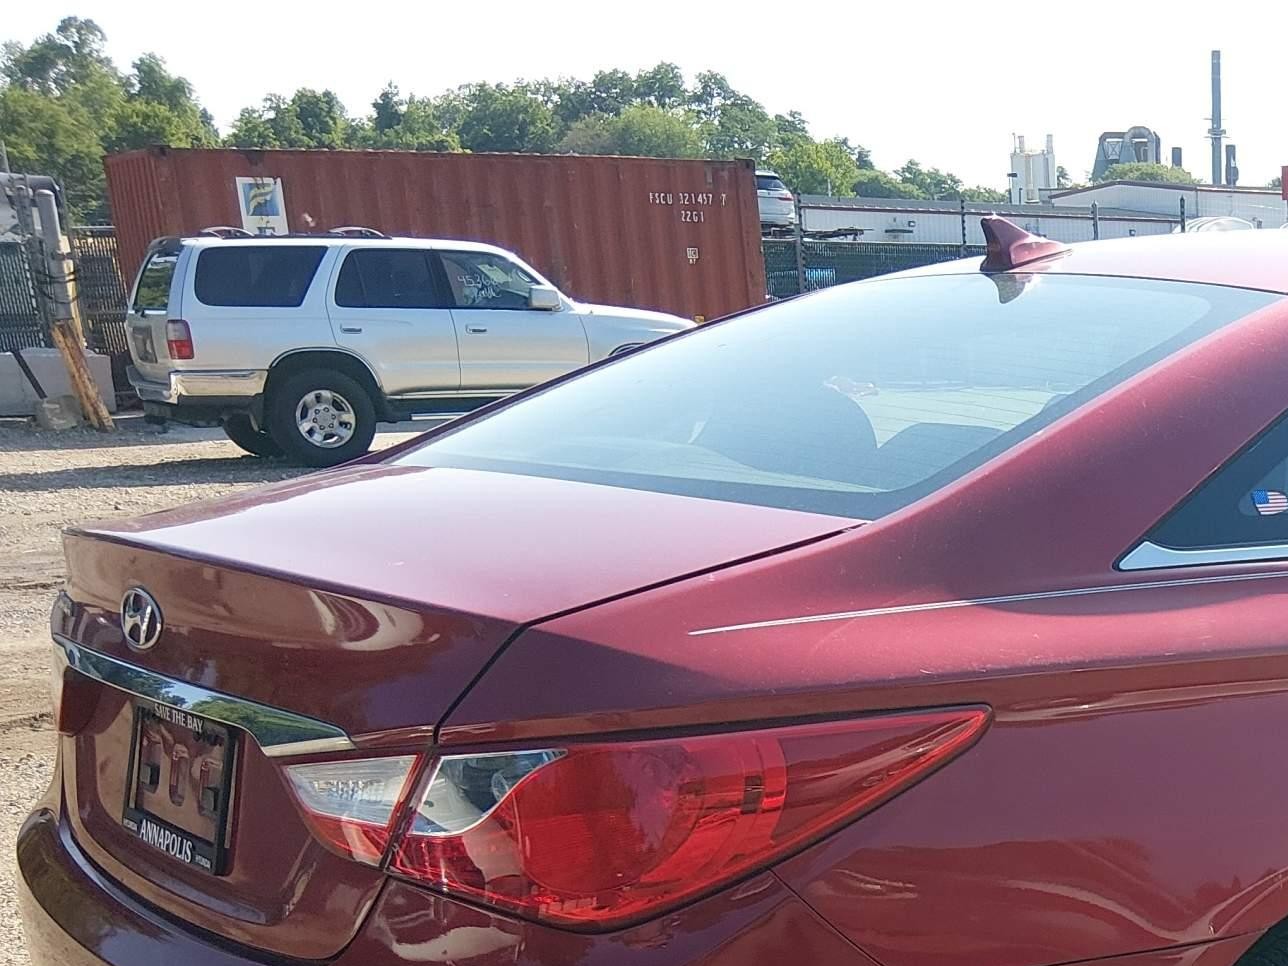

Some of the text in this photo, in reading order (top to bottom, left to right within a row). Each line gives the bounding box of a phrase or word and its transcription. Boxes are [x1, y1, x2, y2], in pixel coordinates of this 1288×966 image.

[649, 192, 673, 204] FSCU
[679, 193, 713, 205] 321457
[680, 210, 704, 222] 22G1
[154, 703, 203, 734] SAVE THE BAY
[139, 819, 193, 863] ANNAPOLIS
